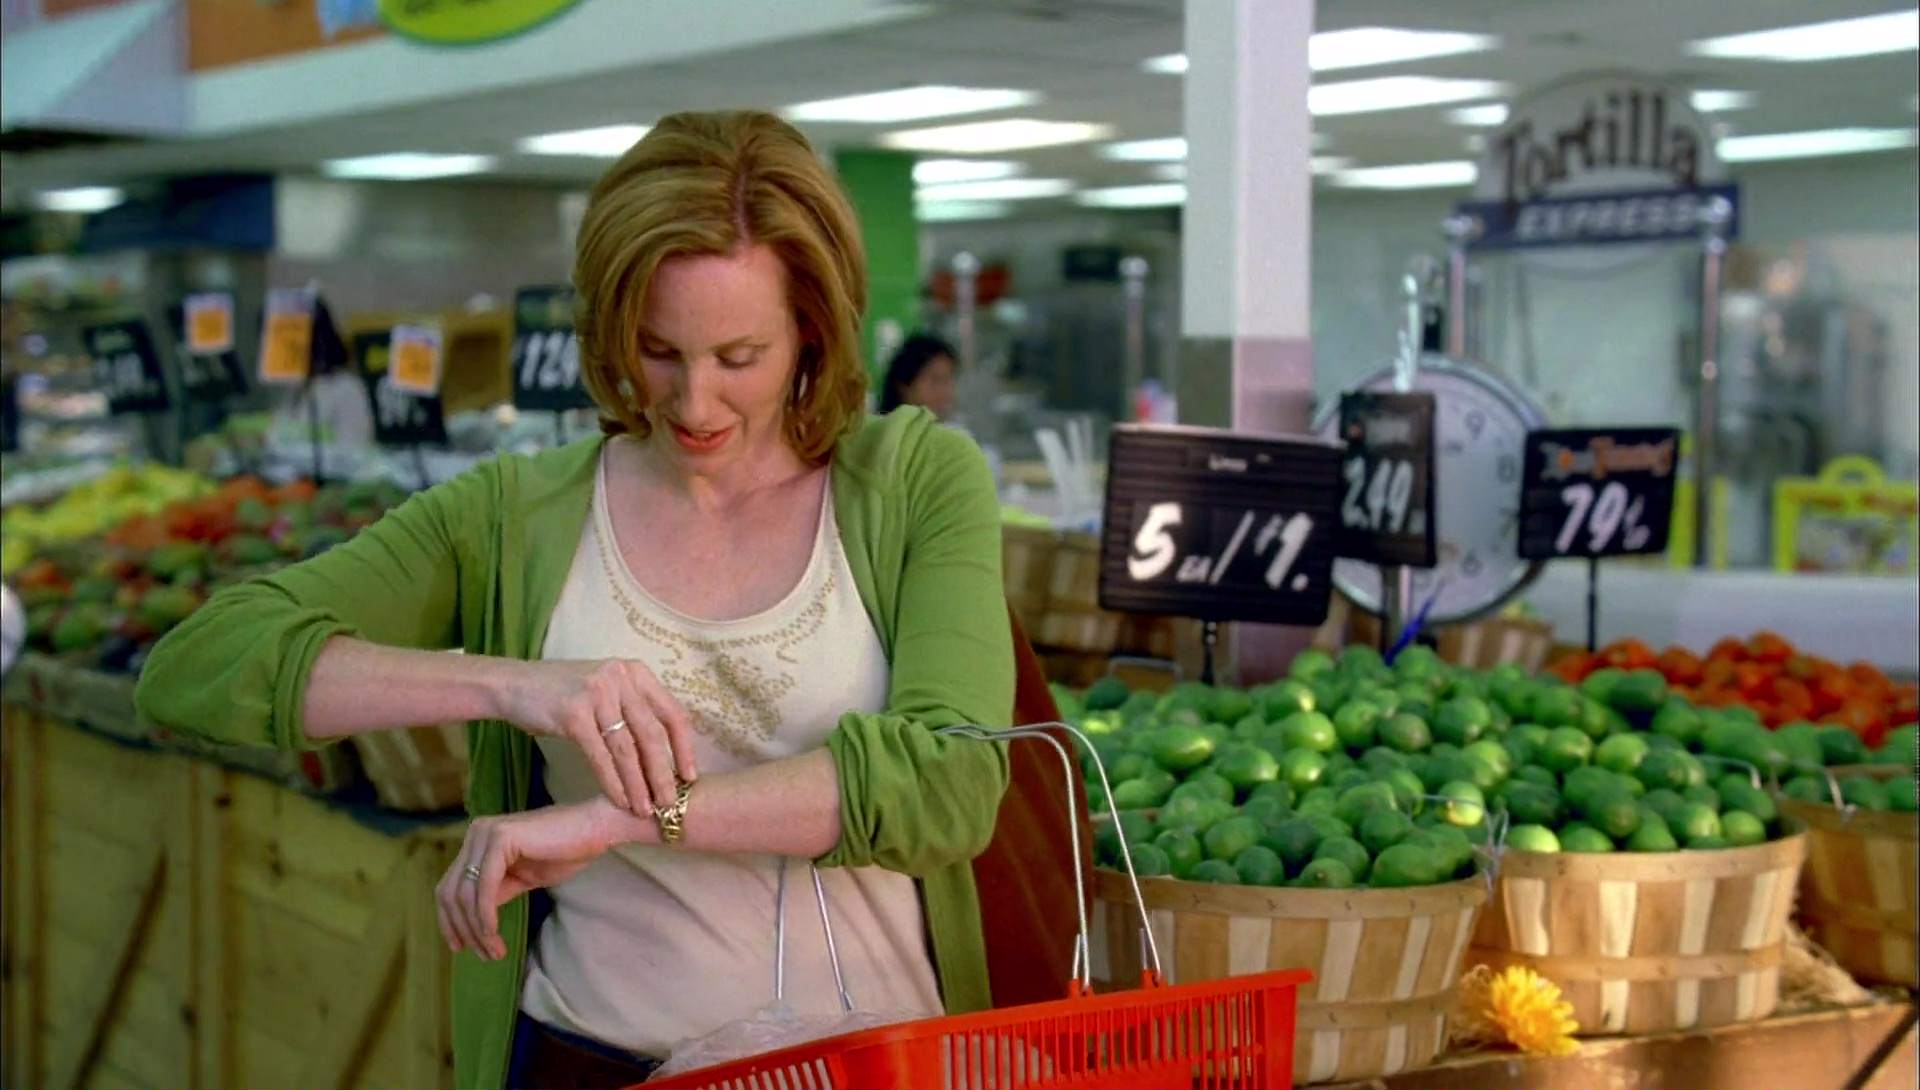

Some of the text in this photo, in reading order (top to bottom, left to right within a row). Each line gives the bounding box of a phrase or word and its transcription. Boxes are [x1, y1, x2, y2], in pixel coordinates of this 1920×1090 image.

[1492, 86, 1698, 215] Tortilla
[1514, 195, 1697, 242] EXPRESS
[1127, 502, 1183, 581] 5
